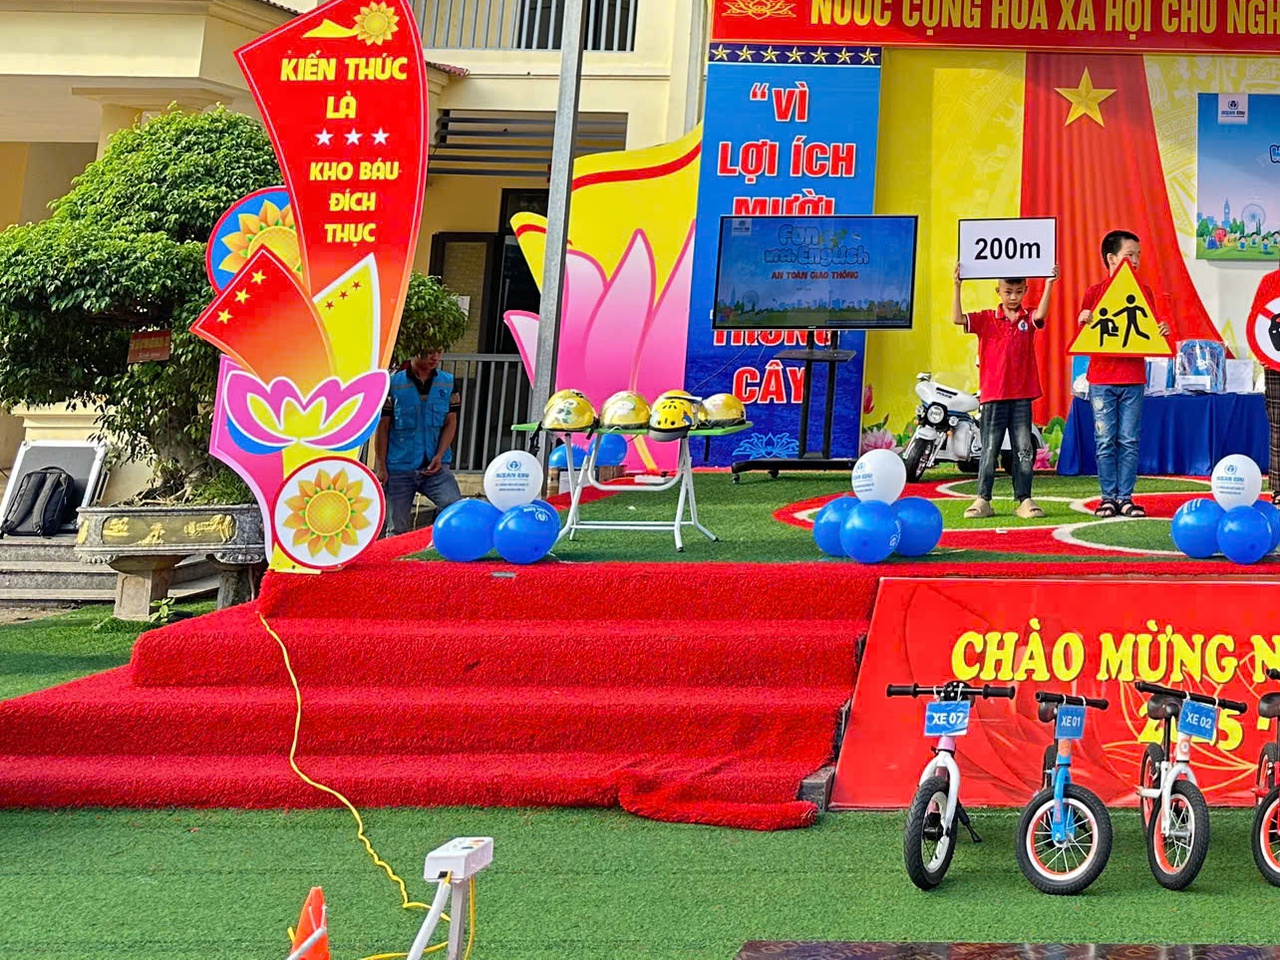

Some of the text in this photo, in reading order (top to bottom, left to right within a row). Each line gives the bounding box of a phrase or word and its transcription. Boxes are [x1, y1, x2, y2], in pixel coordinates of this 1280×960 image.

[280, 50, 408, 81] KIẾN THỨC
[326, 91, 357, 119] LÀ
[309, 158, 399, 181] KHO BÁU
[717, 136, 855, 184] LỢI ÍCH
[329, 188, 375, 211] ĐÍCH
[974, 237, 1041, 260] 200m
[952, 618, 1085, 682] CHÀO
[1097, 619, 1239, 683] MỪNG
[932, 712, 965, 725] XE 07
[1061, 715, 1081, 727] XE 01
[1186, 712, 1212, 729] XE 02
